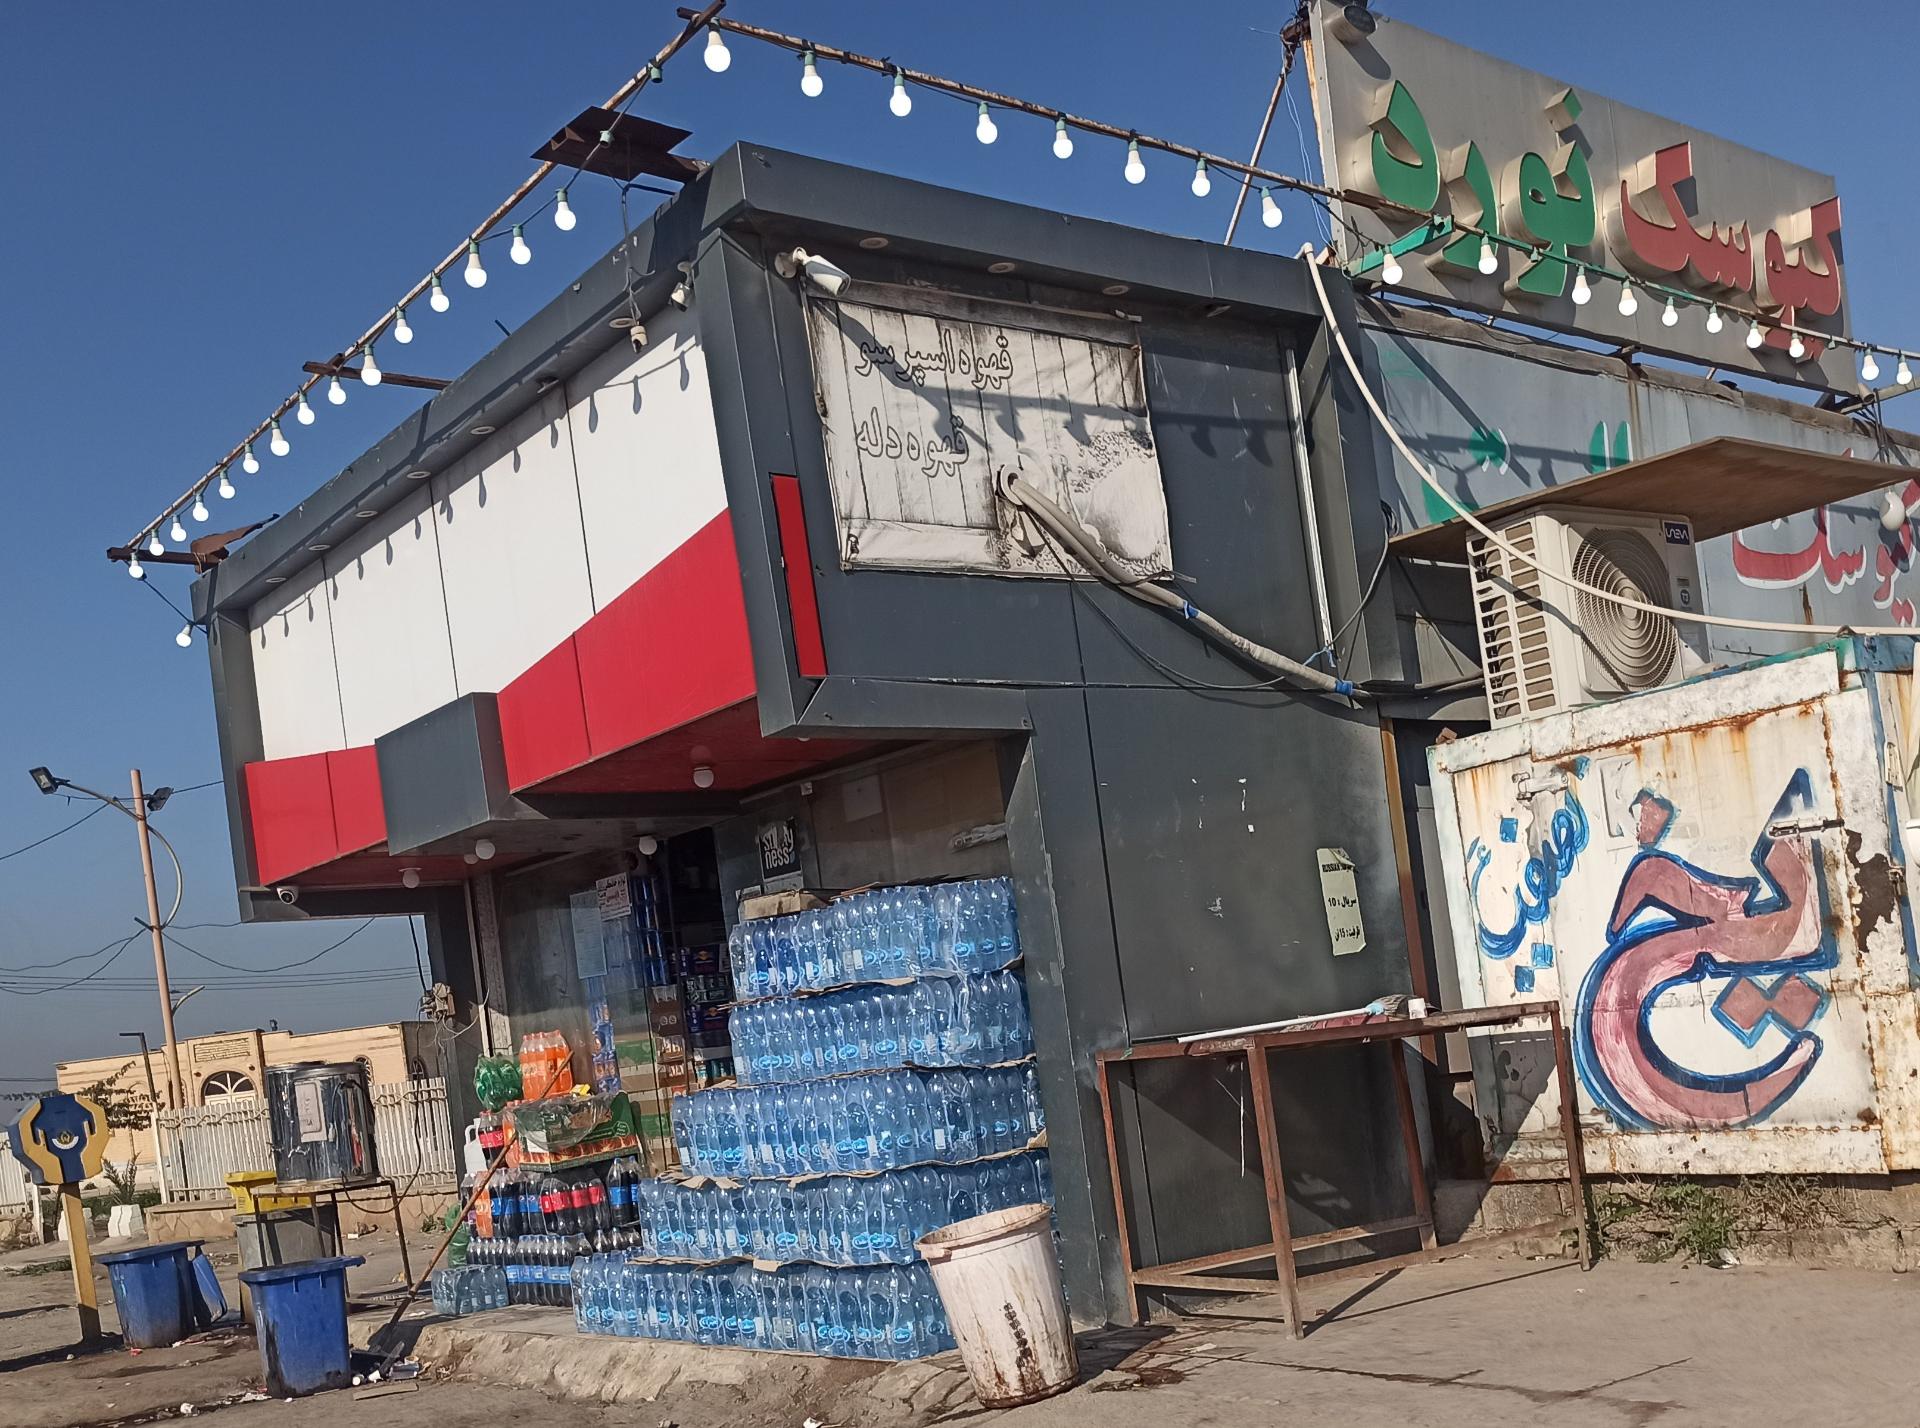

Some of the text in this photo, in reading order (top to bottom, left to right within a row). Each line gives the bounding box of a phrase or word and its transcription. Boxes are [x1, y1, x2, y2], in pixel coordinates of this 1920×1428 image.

[957, 333, 1016, 390] قهوه
[855, 405, 970, 478] قهوه دله
